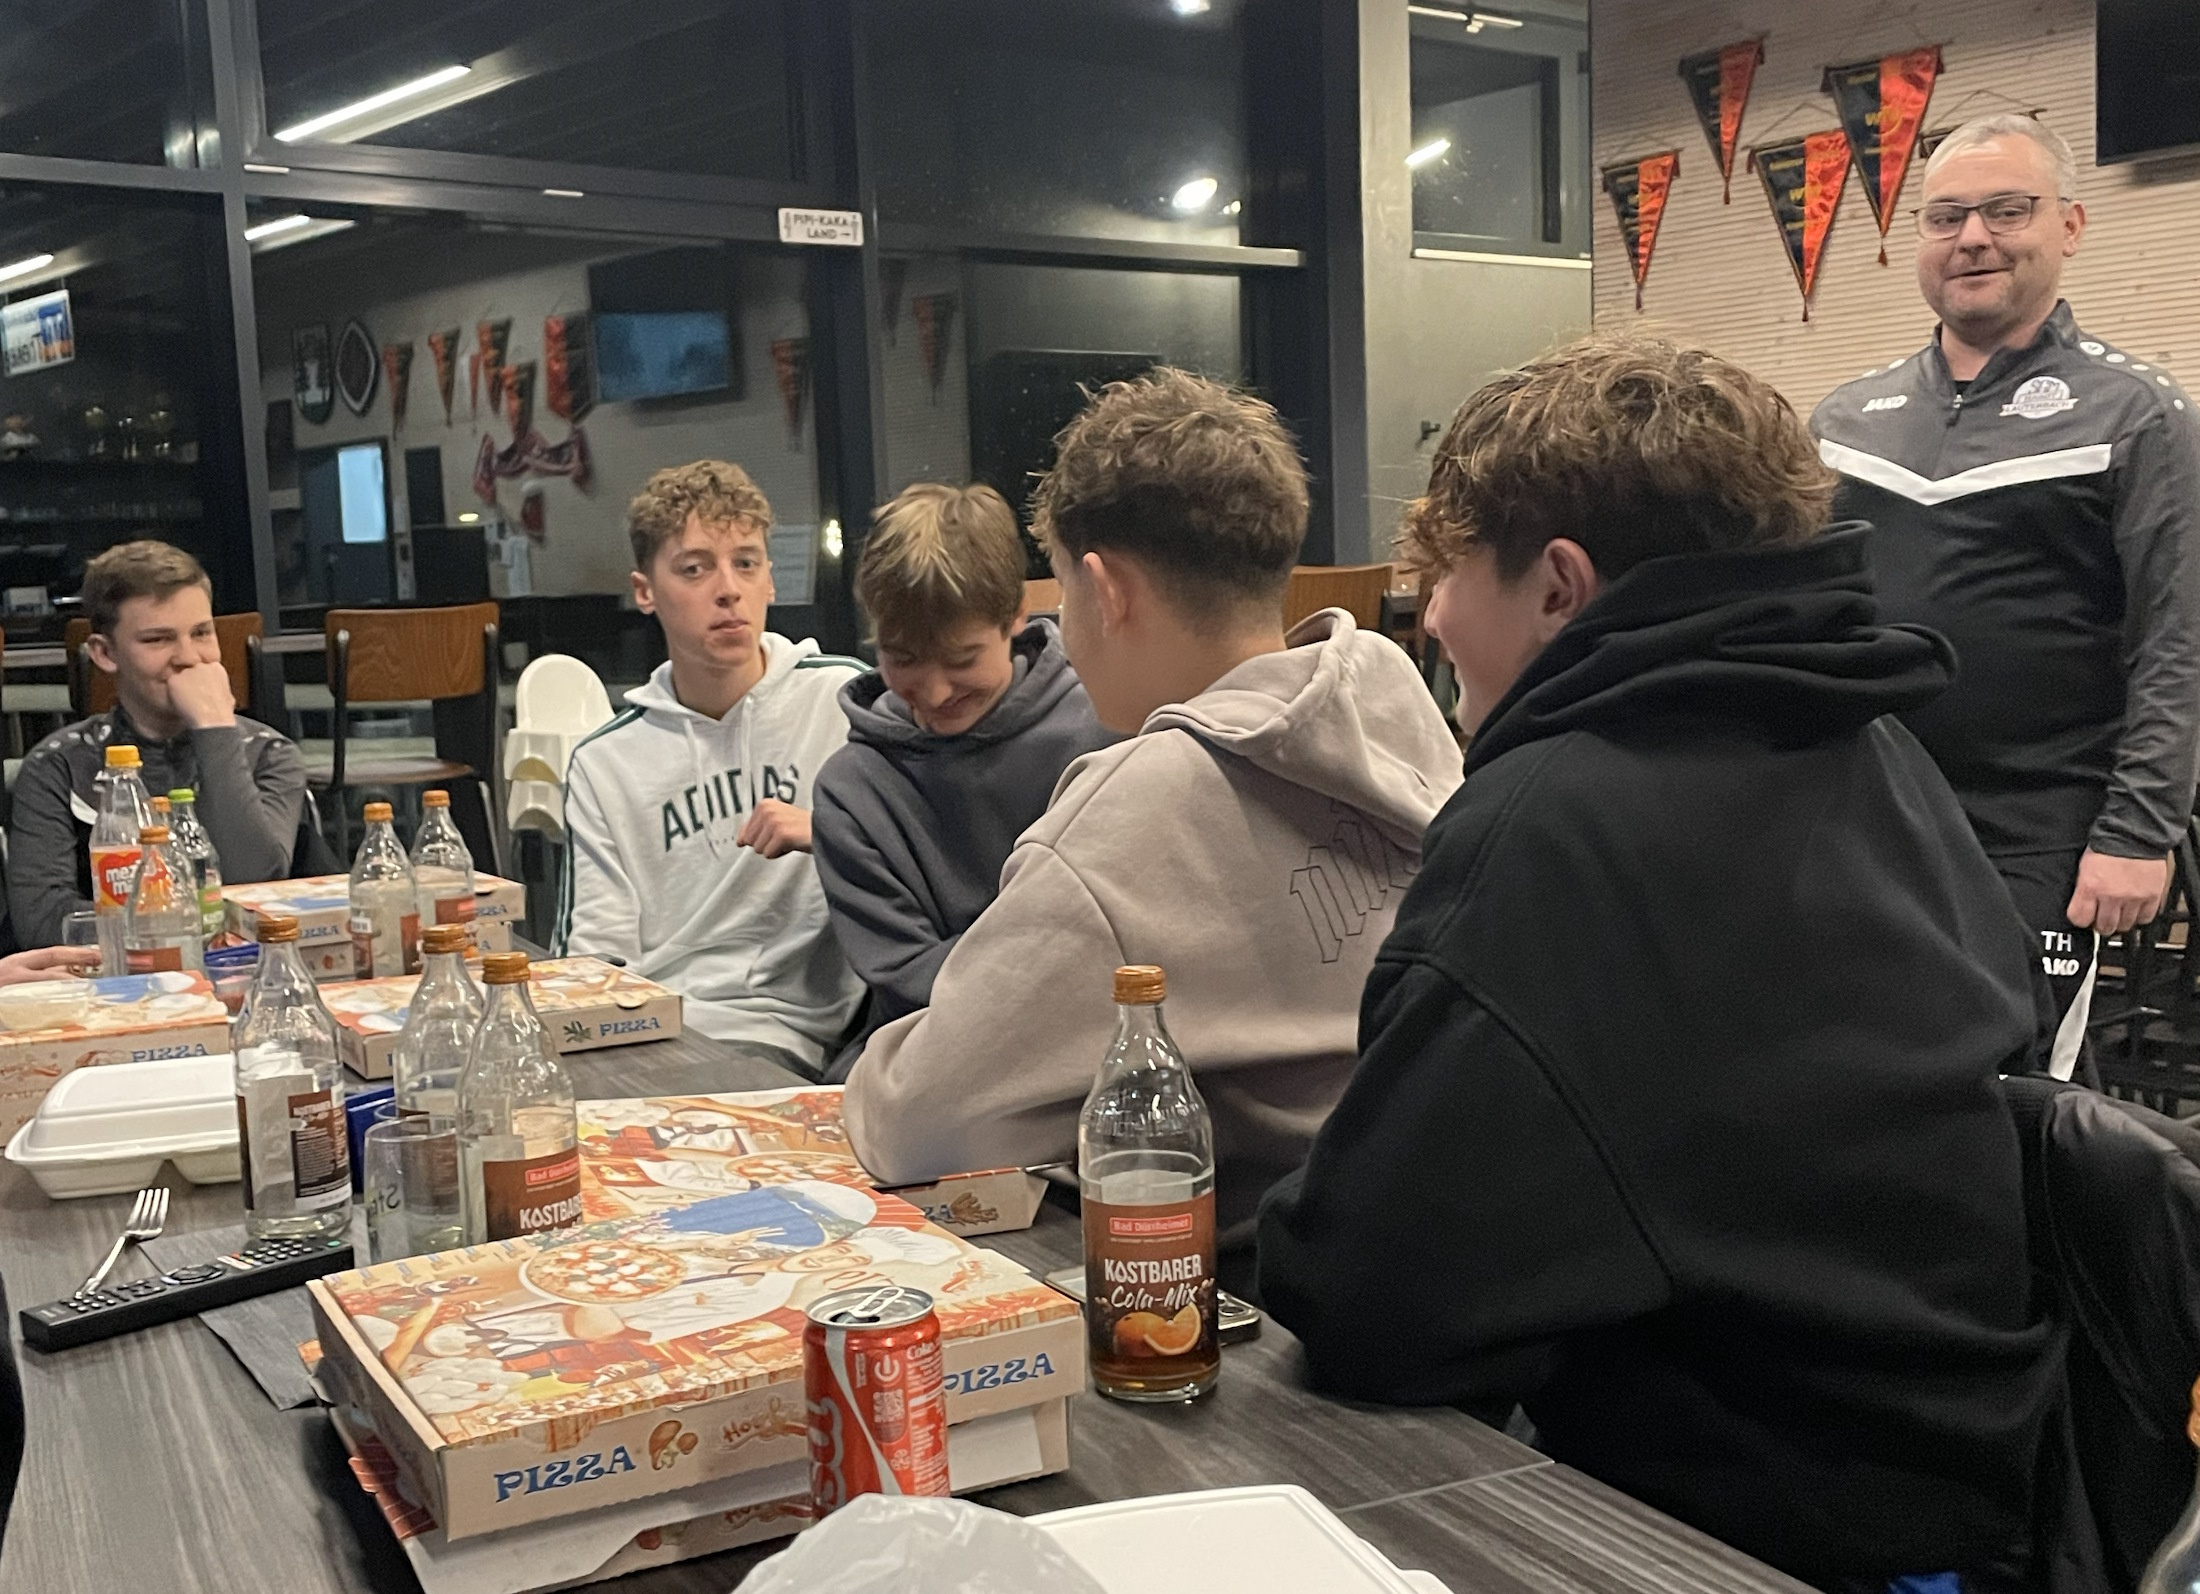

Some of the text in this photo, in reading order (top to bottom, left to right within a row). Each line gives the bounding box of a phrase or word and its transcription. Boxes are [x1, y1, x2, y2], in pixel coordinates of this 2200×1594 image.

[793, 213, 848, 226] PIPI-KAKA
[807, 227, 837, 239] LAND
[2041, 930, 2073, 953] TH
[600, 1017, 663, 1037] PIZZA
[1104, 1254, 1203, 1284] KOSTBARER
[1110, 1283, 1200, 1311] Cola-Mix
[494, 1445, 636, 1503] PIZZA
